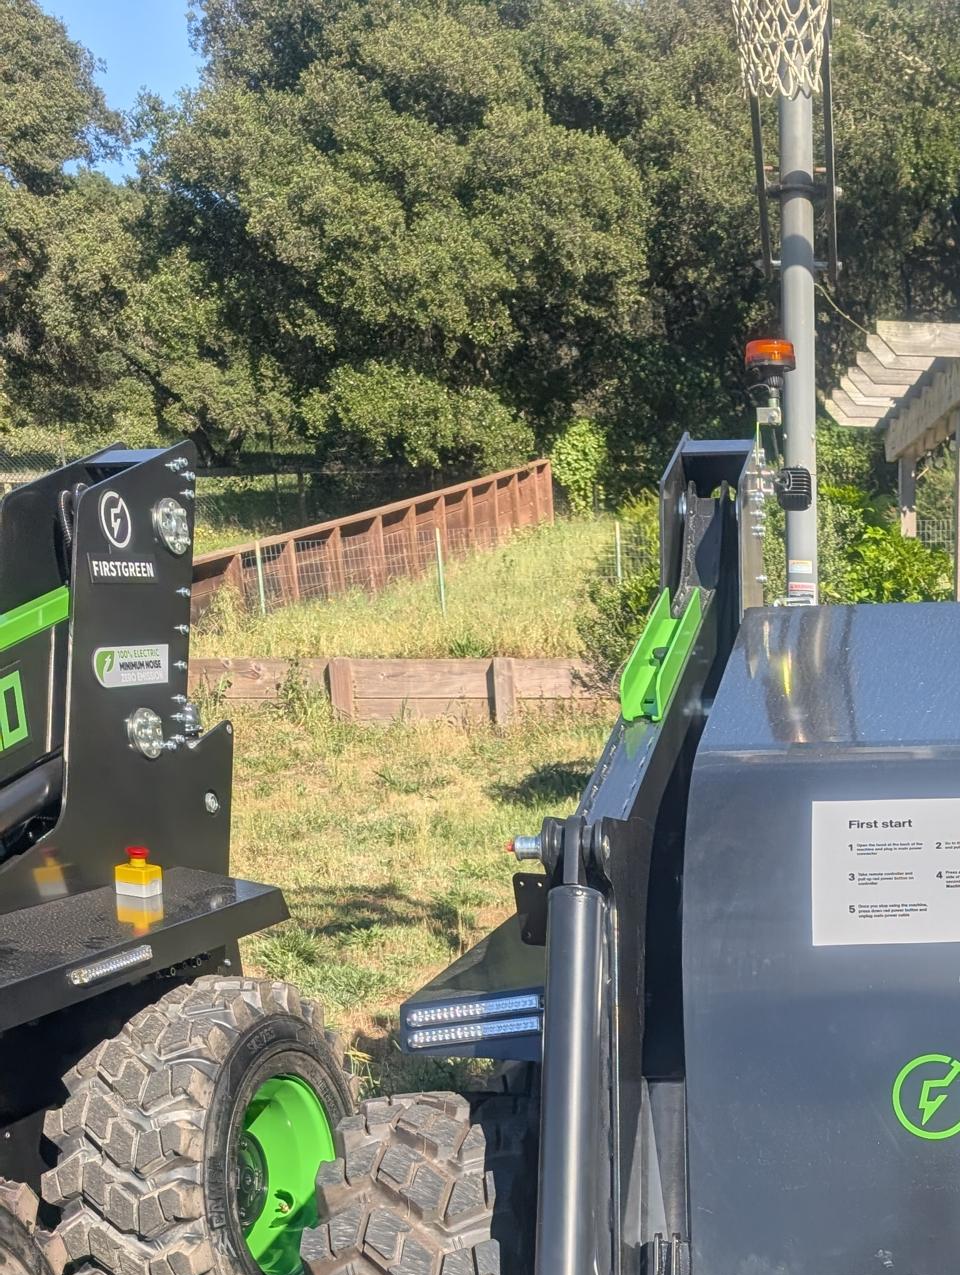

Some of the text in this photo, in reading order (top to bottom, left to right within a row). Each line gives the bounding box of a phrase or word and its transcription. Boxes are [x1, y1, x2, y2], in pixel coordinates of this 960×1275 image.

[92, 560, 155, 577] FIRSTGREEN
[133, 648, 159, 658] ELECTRIC
[119, 659, 162, 671] MINIMUM NOISE
[0, 670, 29, 751] 0
[848, 818, 912, 829] First start
[936, 842, 942, 850] 2
[848, 872, 856, 882] 3
[936, 870, 943, 880] 4
[849, 904, 856, 914] 5
